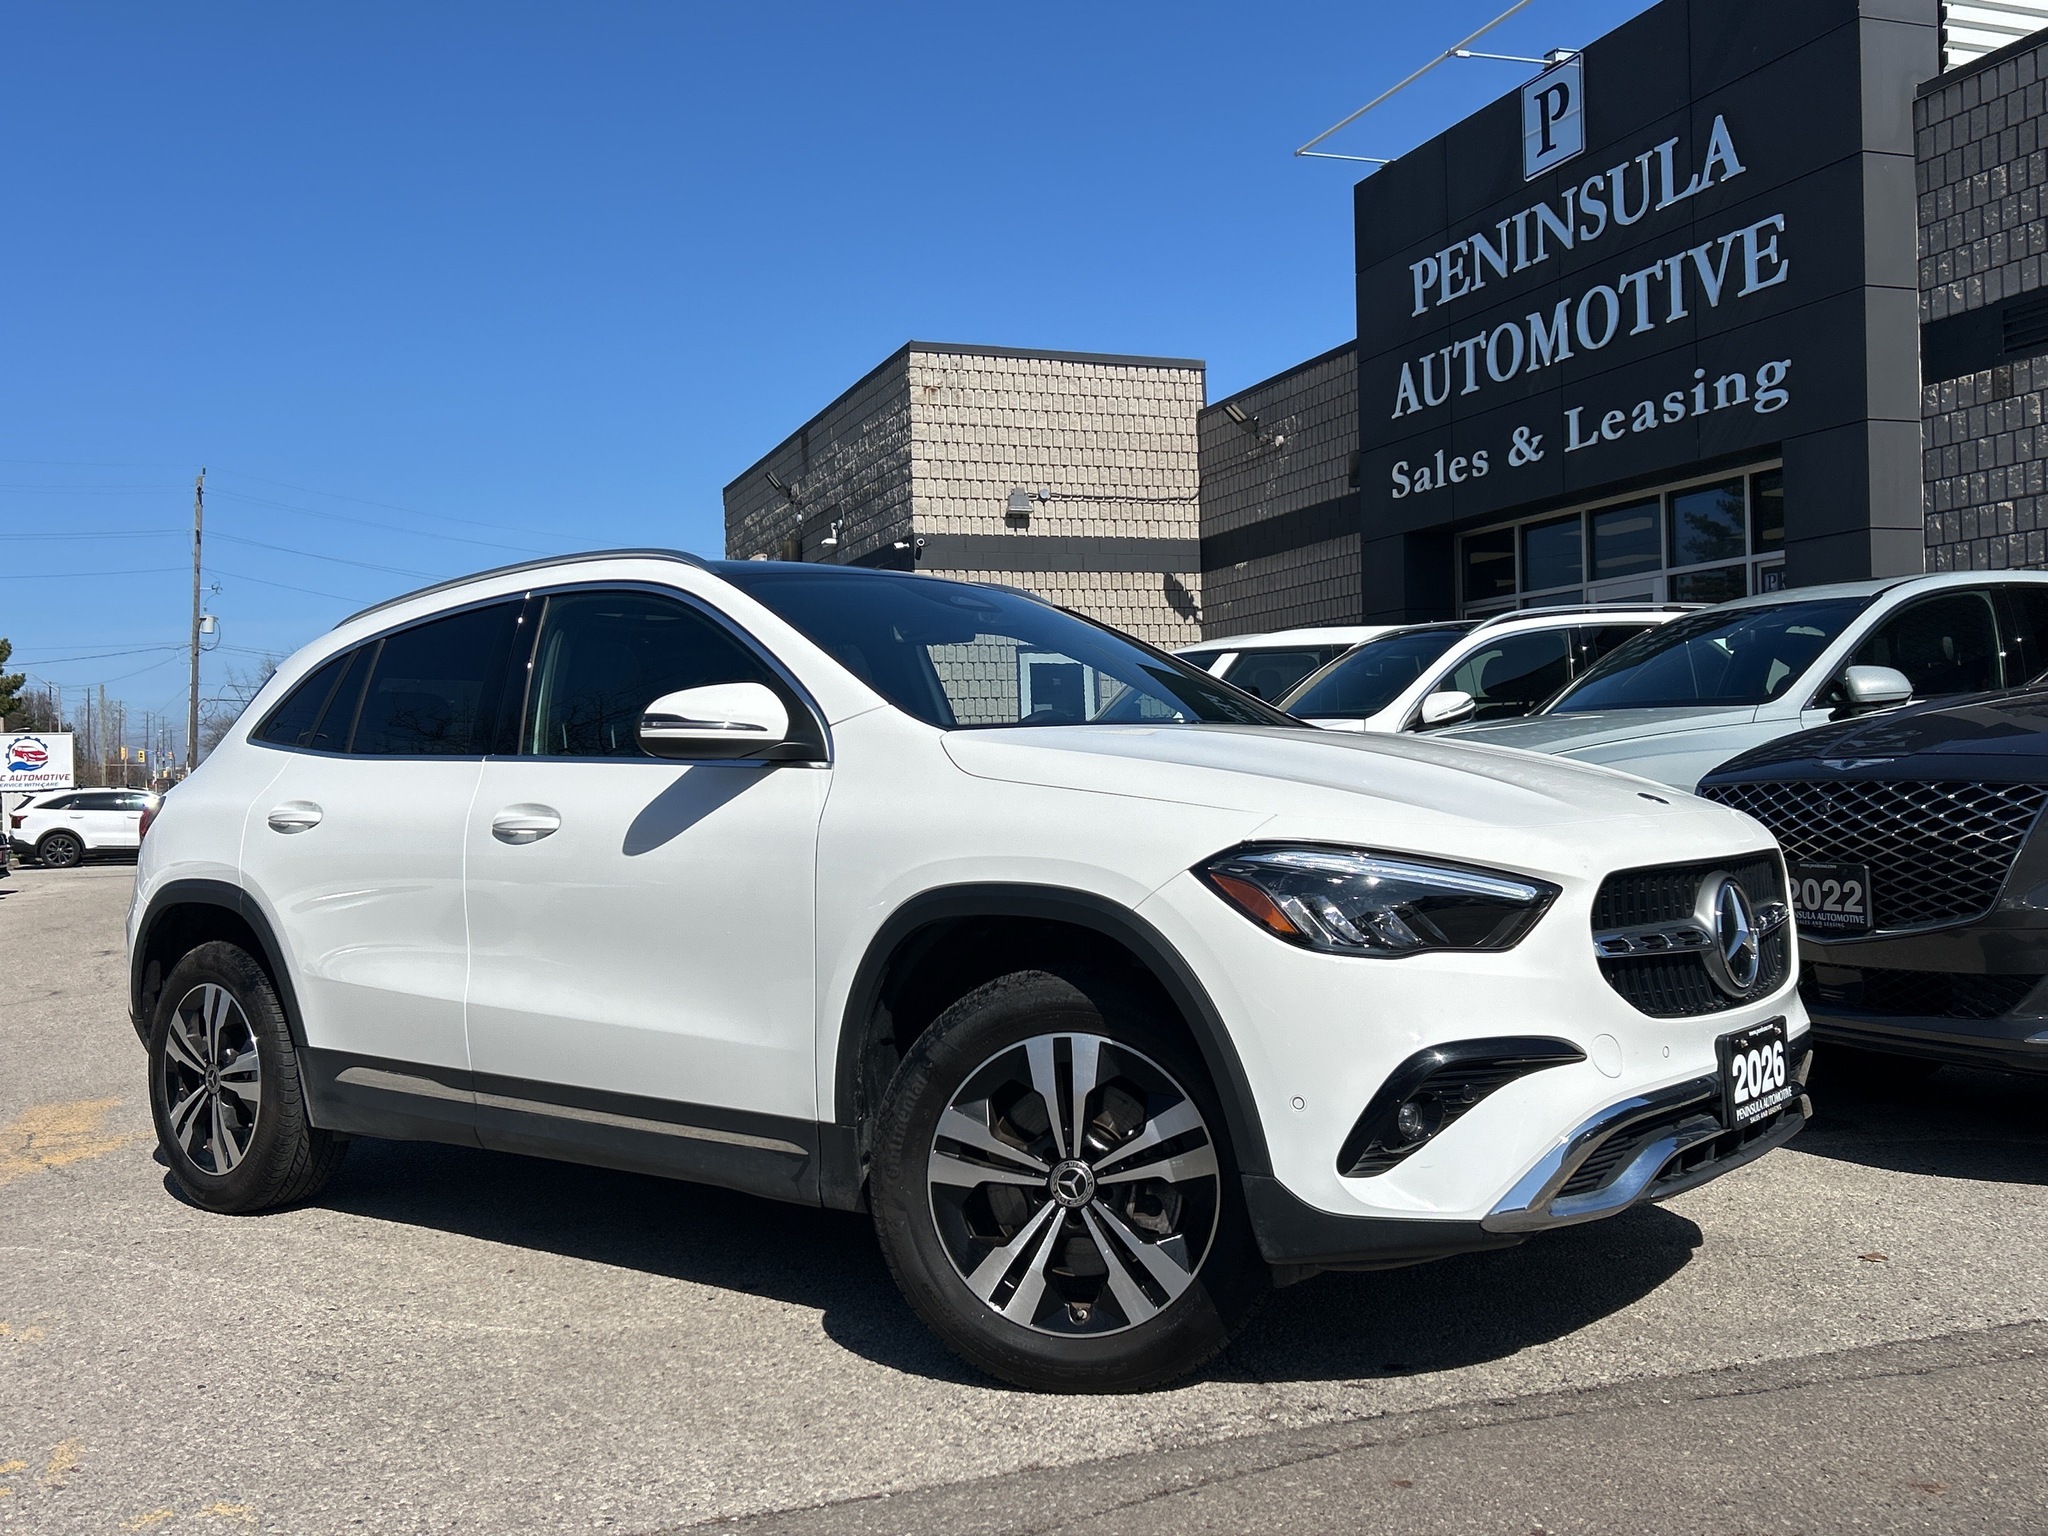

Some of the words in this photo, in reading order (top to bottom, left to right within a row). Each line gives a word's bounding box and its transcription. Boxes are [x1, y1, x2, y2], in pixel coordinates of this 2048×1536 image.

[1533, 81, 1571, 158] P
[1408, 114, 1746, 318] PENINSULA
[1391, 213, 1790, 420] AUTOMOTIVE
[1391, 449, 1490, 499] Sales
[1507, 425, 1545, 468] &
[1563, 358, 1792, 453] Leasing
[1789, 877, 1863, 913] 2022
[1816, 912, 1865, 924] AUTOMOTIVE
[1732, 1040, 1785, 1104] 2026
[1736, 1098, 1763, 1122] PENINSULA
[1763, 1085, 1793, 1108] AUTOMOTIVE
